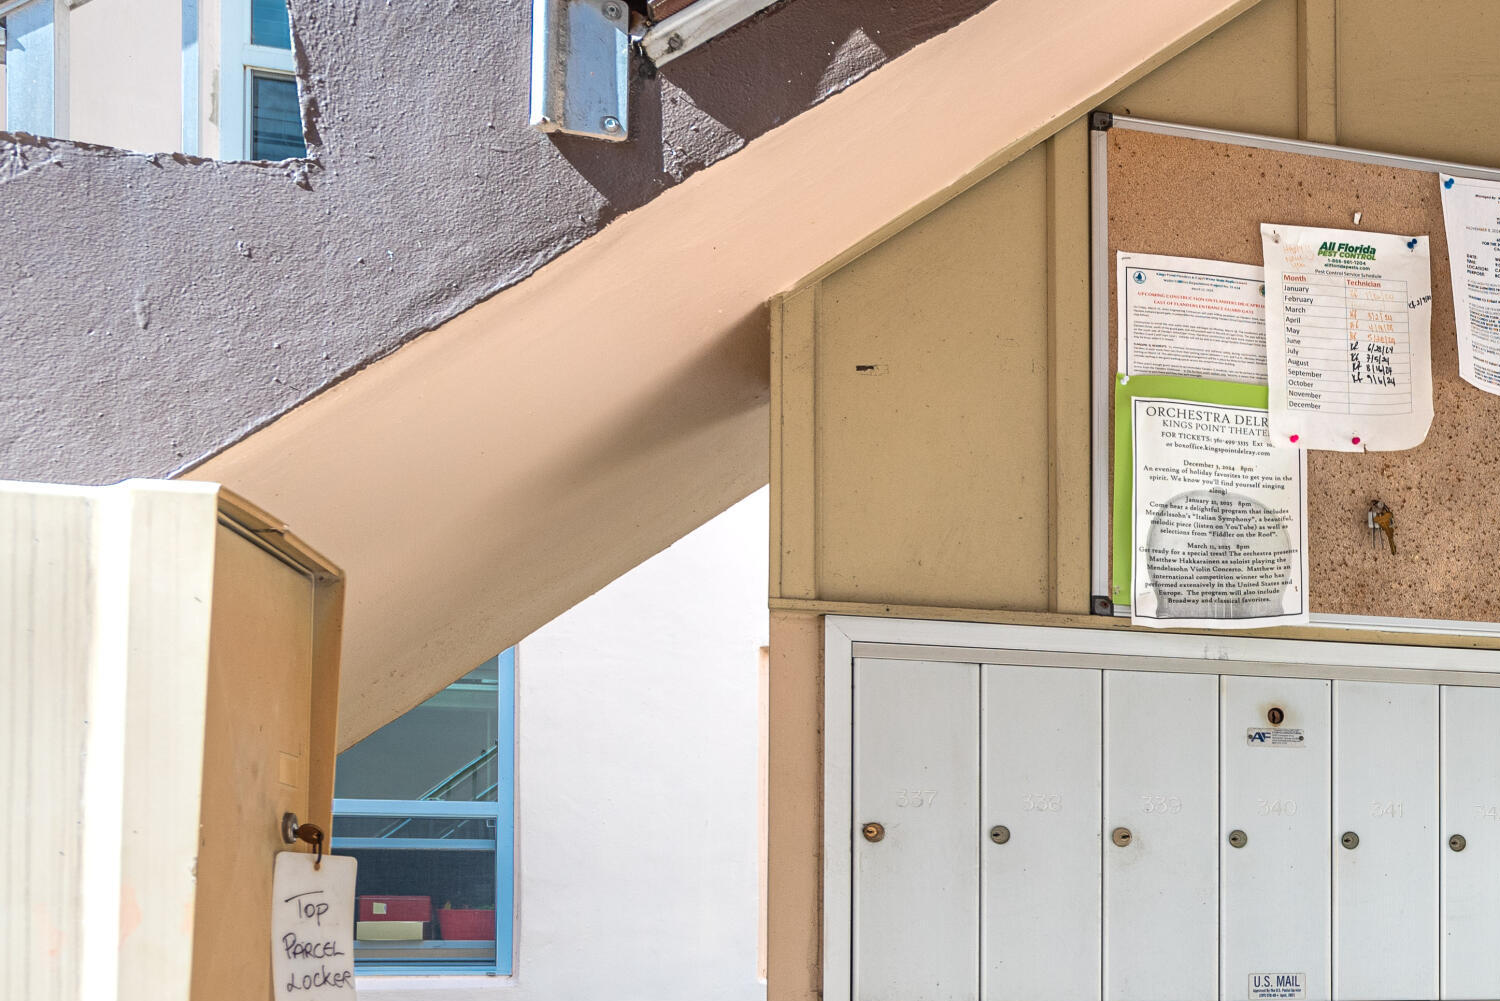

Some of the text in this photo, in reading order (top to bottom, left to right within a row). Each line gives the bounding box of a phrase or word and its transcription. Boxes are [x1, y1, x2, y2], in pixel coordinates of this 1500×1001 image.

[1319, 242, 1376, 254] All Florida
[1339, 252, 1376, 260] CONTROL
[1284, 274, 1381, 288] Month Technician
[1284, 285, 1309, 293] January
[1285, 296, 1313, 304] February
[1286, 316, 1301, 324] April
[1287, 348, 1299, 356] July
[1288, 358, 1309, 366] August
[1288, 369, 1322, 378] September
[1288, 380, 1313, 388] October
[1289, 390, 1321, 399] November
[1289, 401, 1320, 410] December
[1146, 407, 1269, 427] ORCHESTRA DELR
[1162, 420, 1270, 437] KINGS POINT THEATE
[1178, 433, 1212, 442] TICKETS:
[1183, 460, 1214, 469] December
[1155, 466, 1180, 475] evening
[1190, 468, 1212, 477] holiday
[1214, 471, 1240, 479] favorites
[1186, 496, 1209, 505] January
[282, 932, 344, 959] PARCEL
[1254, 975, 1301, 988] U.S. MAIL
